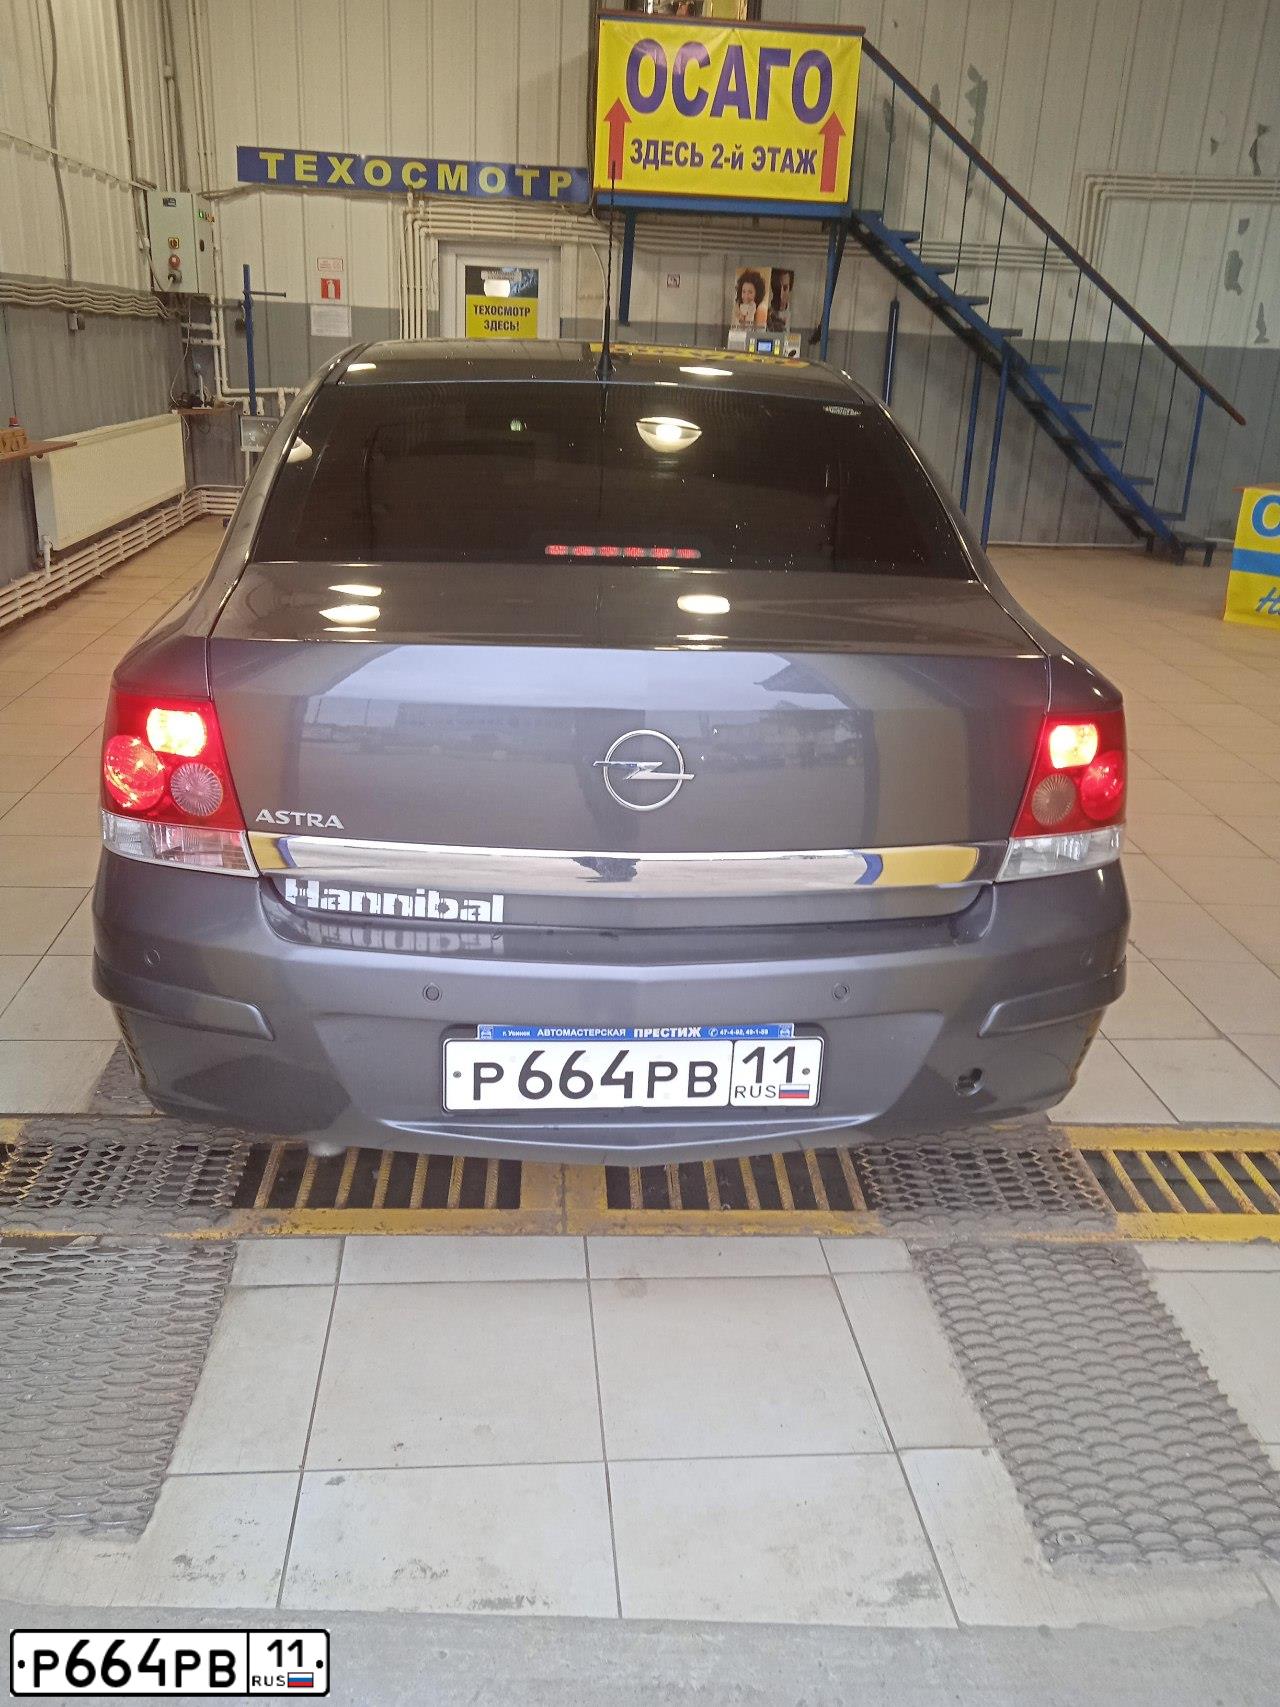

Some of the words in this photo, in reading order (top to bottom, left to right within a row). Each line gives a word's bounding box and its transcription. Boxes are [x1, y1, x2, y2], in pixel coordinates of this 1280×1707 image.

[626, 38, 833, 125] ОСАГО
[630, 138, 704, 172] ЗДЕСЬ
[711, 142, 744, 171] 2-й
[751, 145, 817, 175] ЭТАЖ
[259, 151, 573, 197] ТЕХОСМОТР
[473, 304, 531, 318] ТЕХОСМОТР
[484, 320, 520, 331] ЗДЕСЬ!
[255, 808, 345, 830] ASTRA
[285, 878, 504, 923] Hannibal
[536, 1028, 627, 1037] АВТОМАСТЕРСКАЯ
[633, 1027, 702, 1038] ПРЕСТИЖ
[473, 1049, 718, 1101] Р664РВ
[742, 1046, 796, 1084] 11
[734, 1085, 777, 1100] RUS
